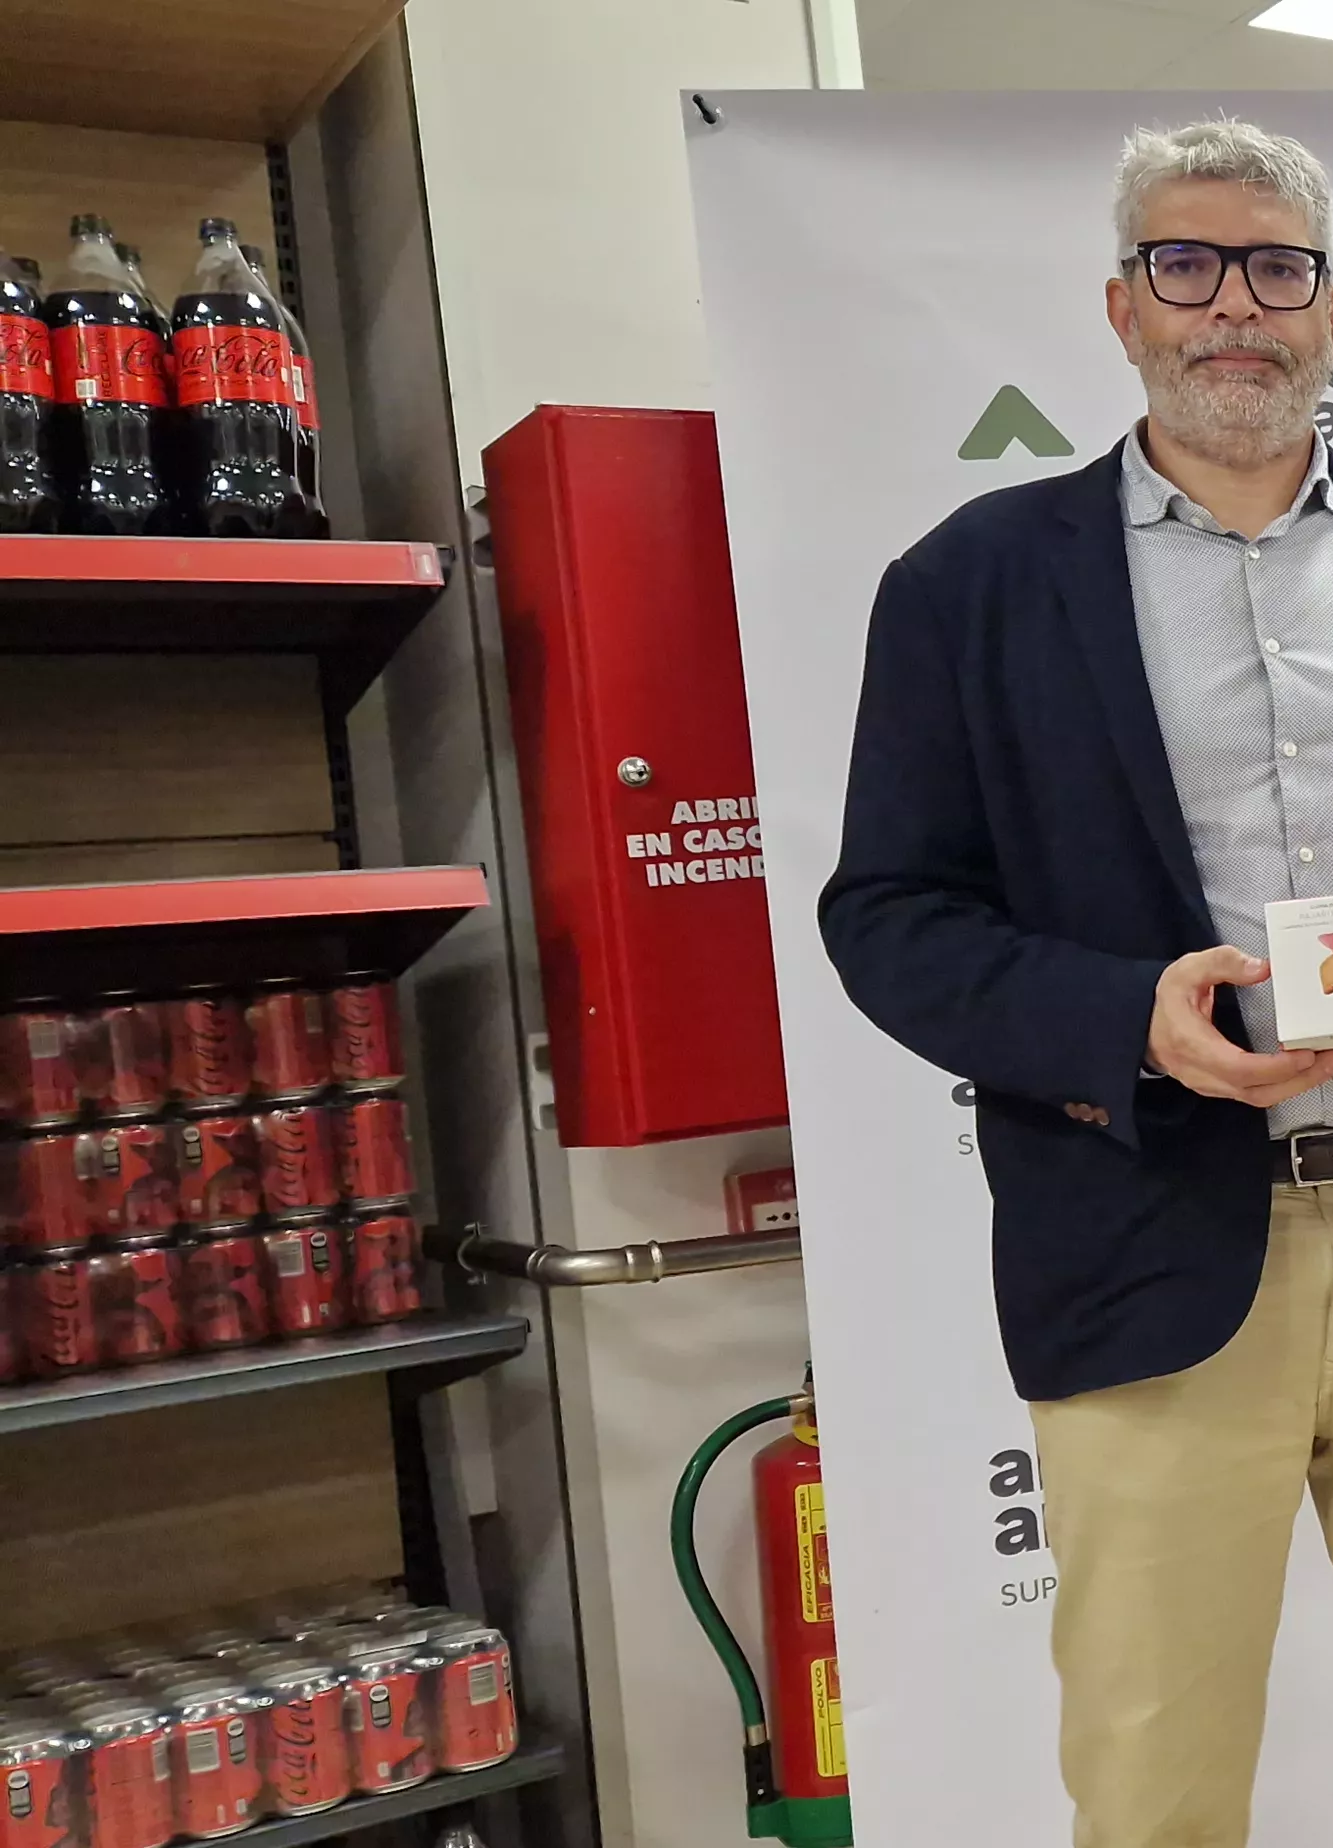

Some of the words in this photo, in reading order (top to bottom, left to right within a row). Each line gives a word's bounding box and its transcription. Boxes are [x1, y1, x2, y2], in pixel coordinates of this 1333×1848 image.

[671, 796, 759, 825] ABRI
[626, 832, 672, 858] EN
[645, 855, 765, 887] INCEND
[803, 1544, 815, 1615] EFICACIA
[815, 1668, 825, 1718] POLVO
